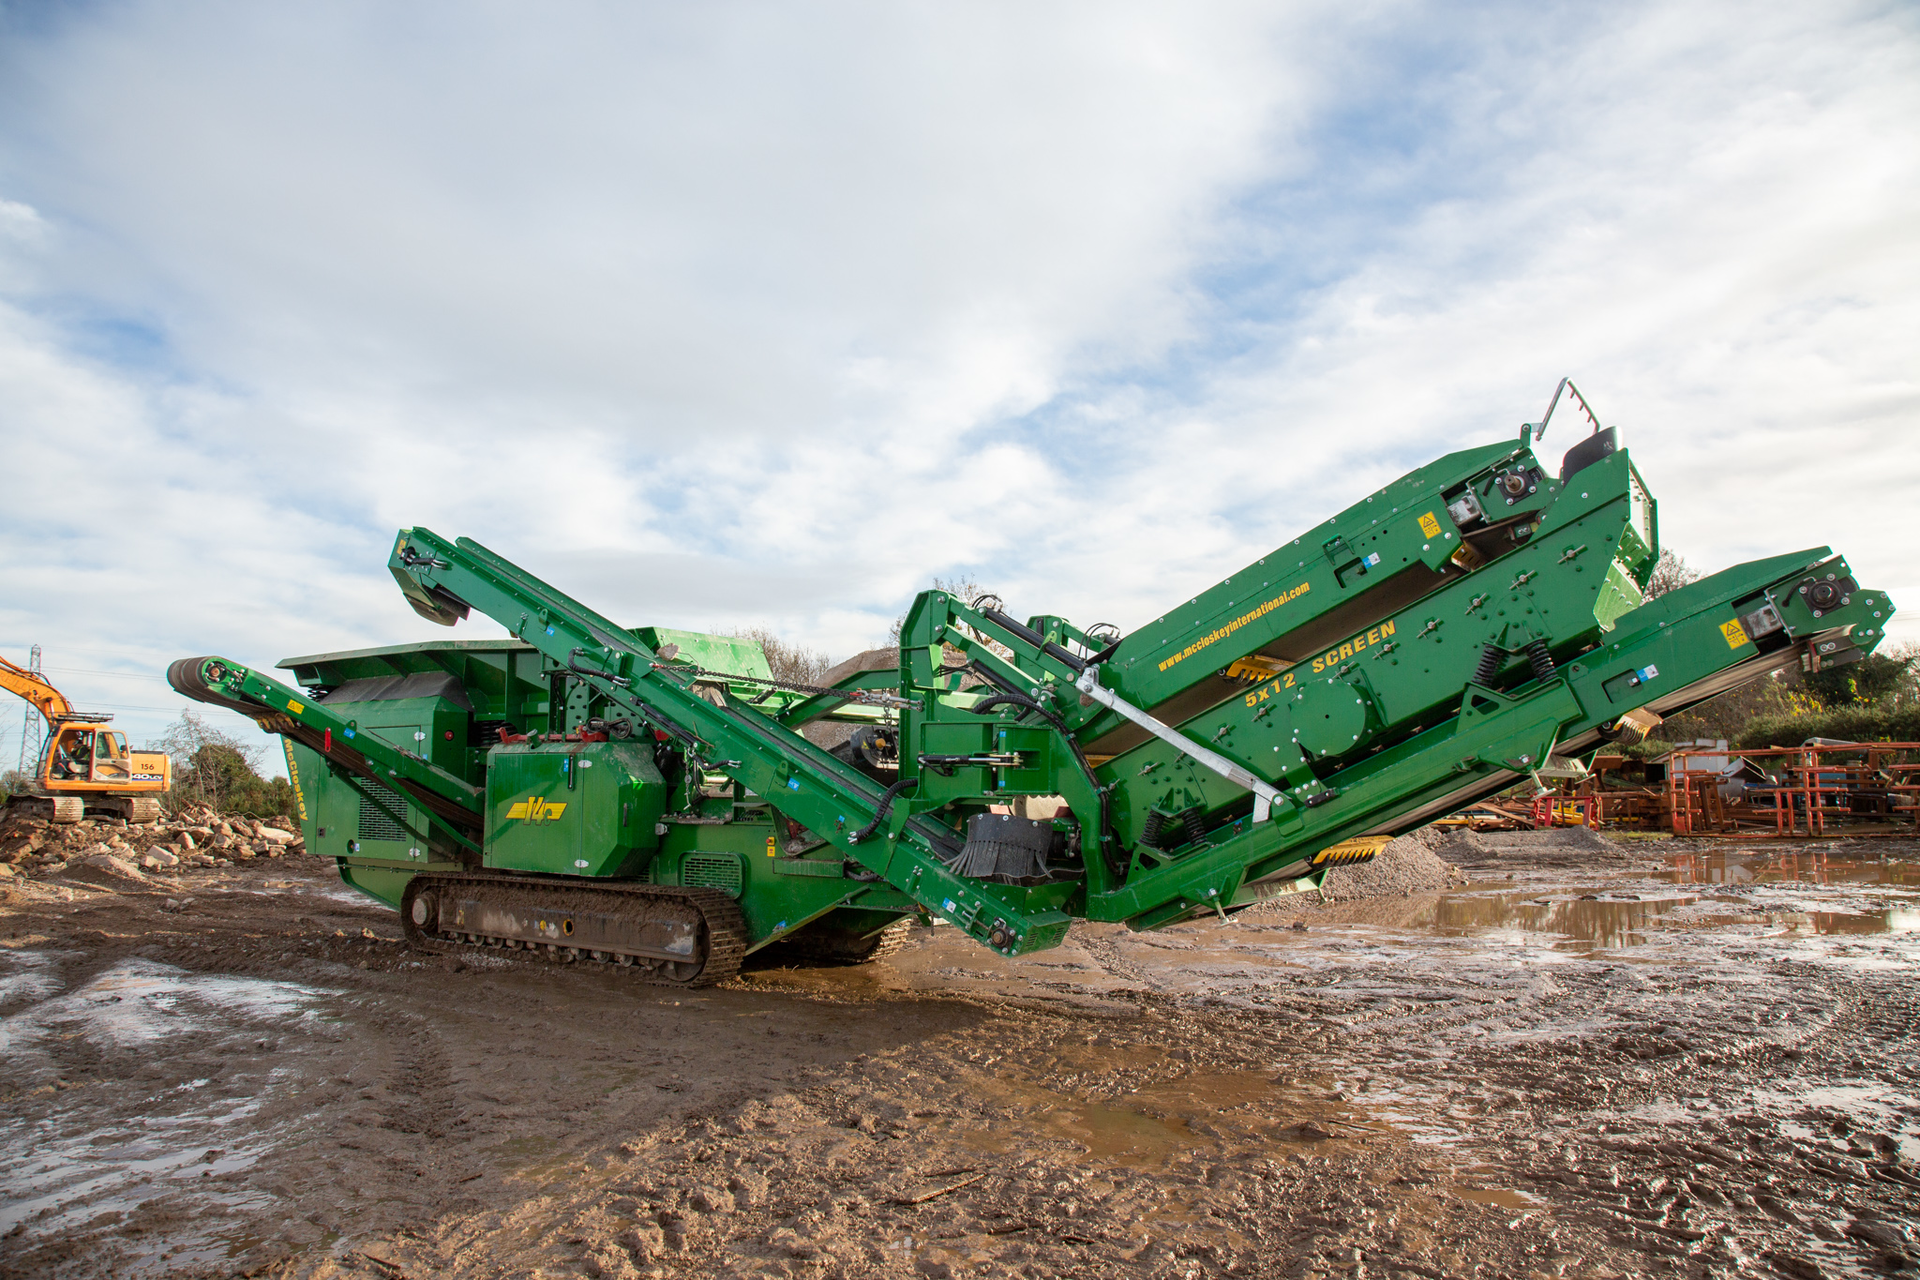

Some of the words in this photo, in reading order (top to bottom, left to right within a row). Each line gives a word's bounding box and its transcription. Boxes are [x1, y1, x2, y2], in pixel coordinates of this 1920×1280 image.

[1158, 582, 1310, 672] www.mccloskeyinternational.com
[1312, 619, 1396, 673] SCREEN
[284, 738, 308, 821] McCloskey
